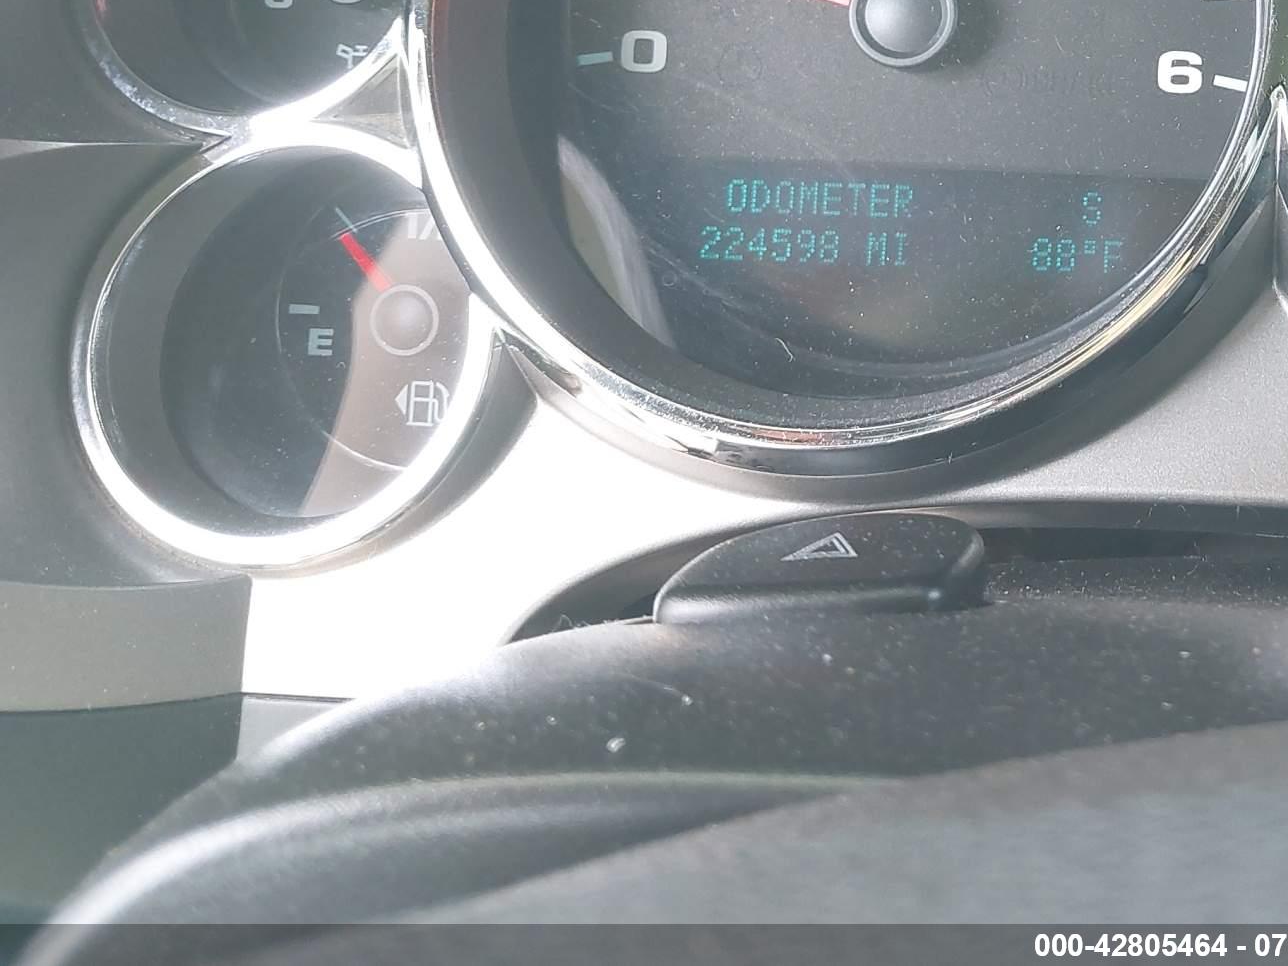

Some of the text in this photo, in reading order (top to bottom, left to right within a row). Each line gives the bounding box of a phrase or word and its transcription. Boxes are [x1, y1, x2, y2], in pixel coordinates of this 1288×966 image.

[622, 30, 667, 72] 0
[1158, 51, 1202, 93] 6
[727, 178, 913, 218] ODOMETER
[1082, 192, 1102, 226] S
[701, 225, 909, 267] 224598 MI
[308, 329, 334, 356] E
